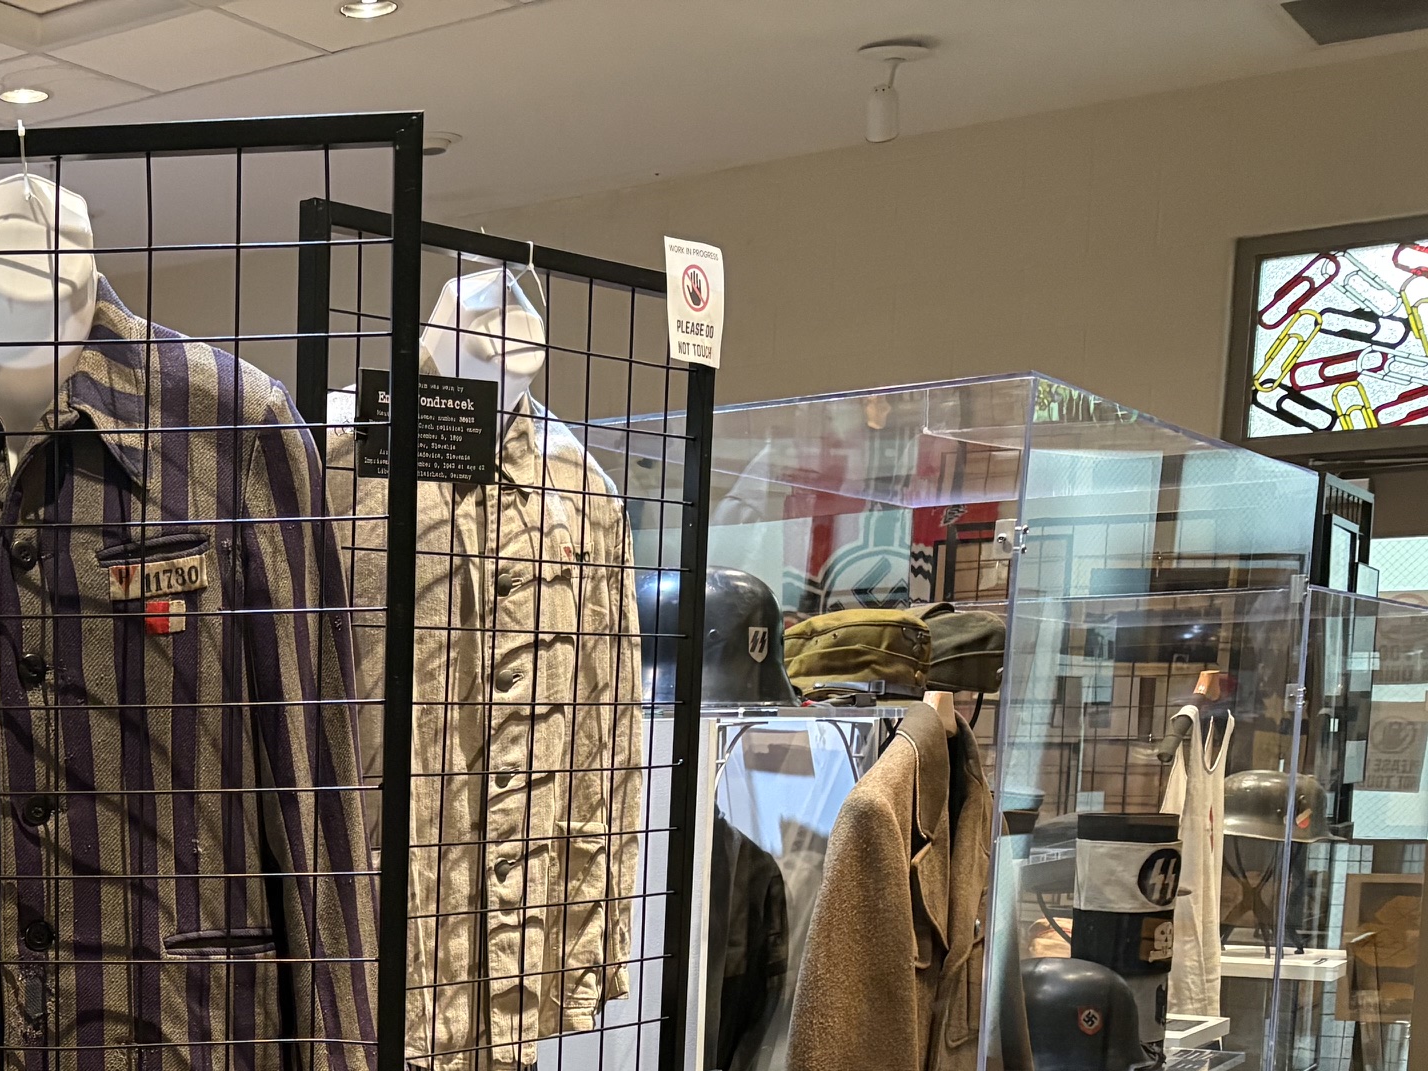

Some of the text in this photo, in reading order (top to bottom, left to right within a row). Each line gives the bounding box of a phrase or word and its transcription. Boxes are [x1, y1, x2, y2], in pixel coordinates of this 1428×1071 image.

[669, 245, 719, 261] WORK IN PROGRESS
[677, 320, 714, 339] PLEASE DO
[678, 341, 712, 359] NOT TOUCH
[418, 394, 475, 410] ondracek
[145, 565, 198, 593] 11730
